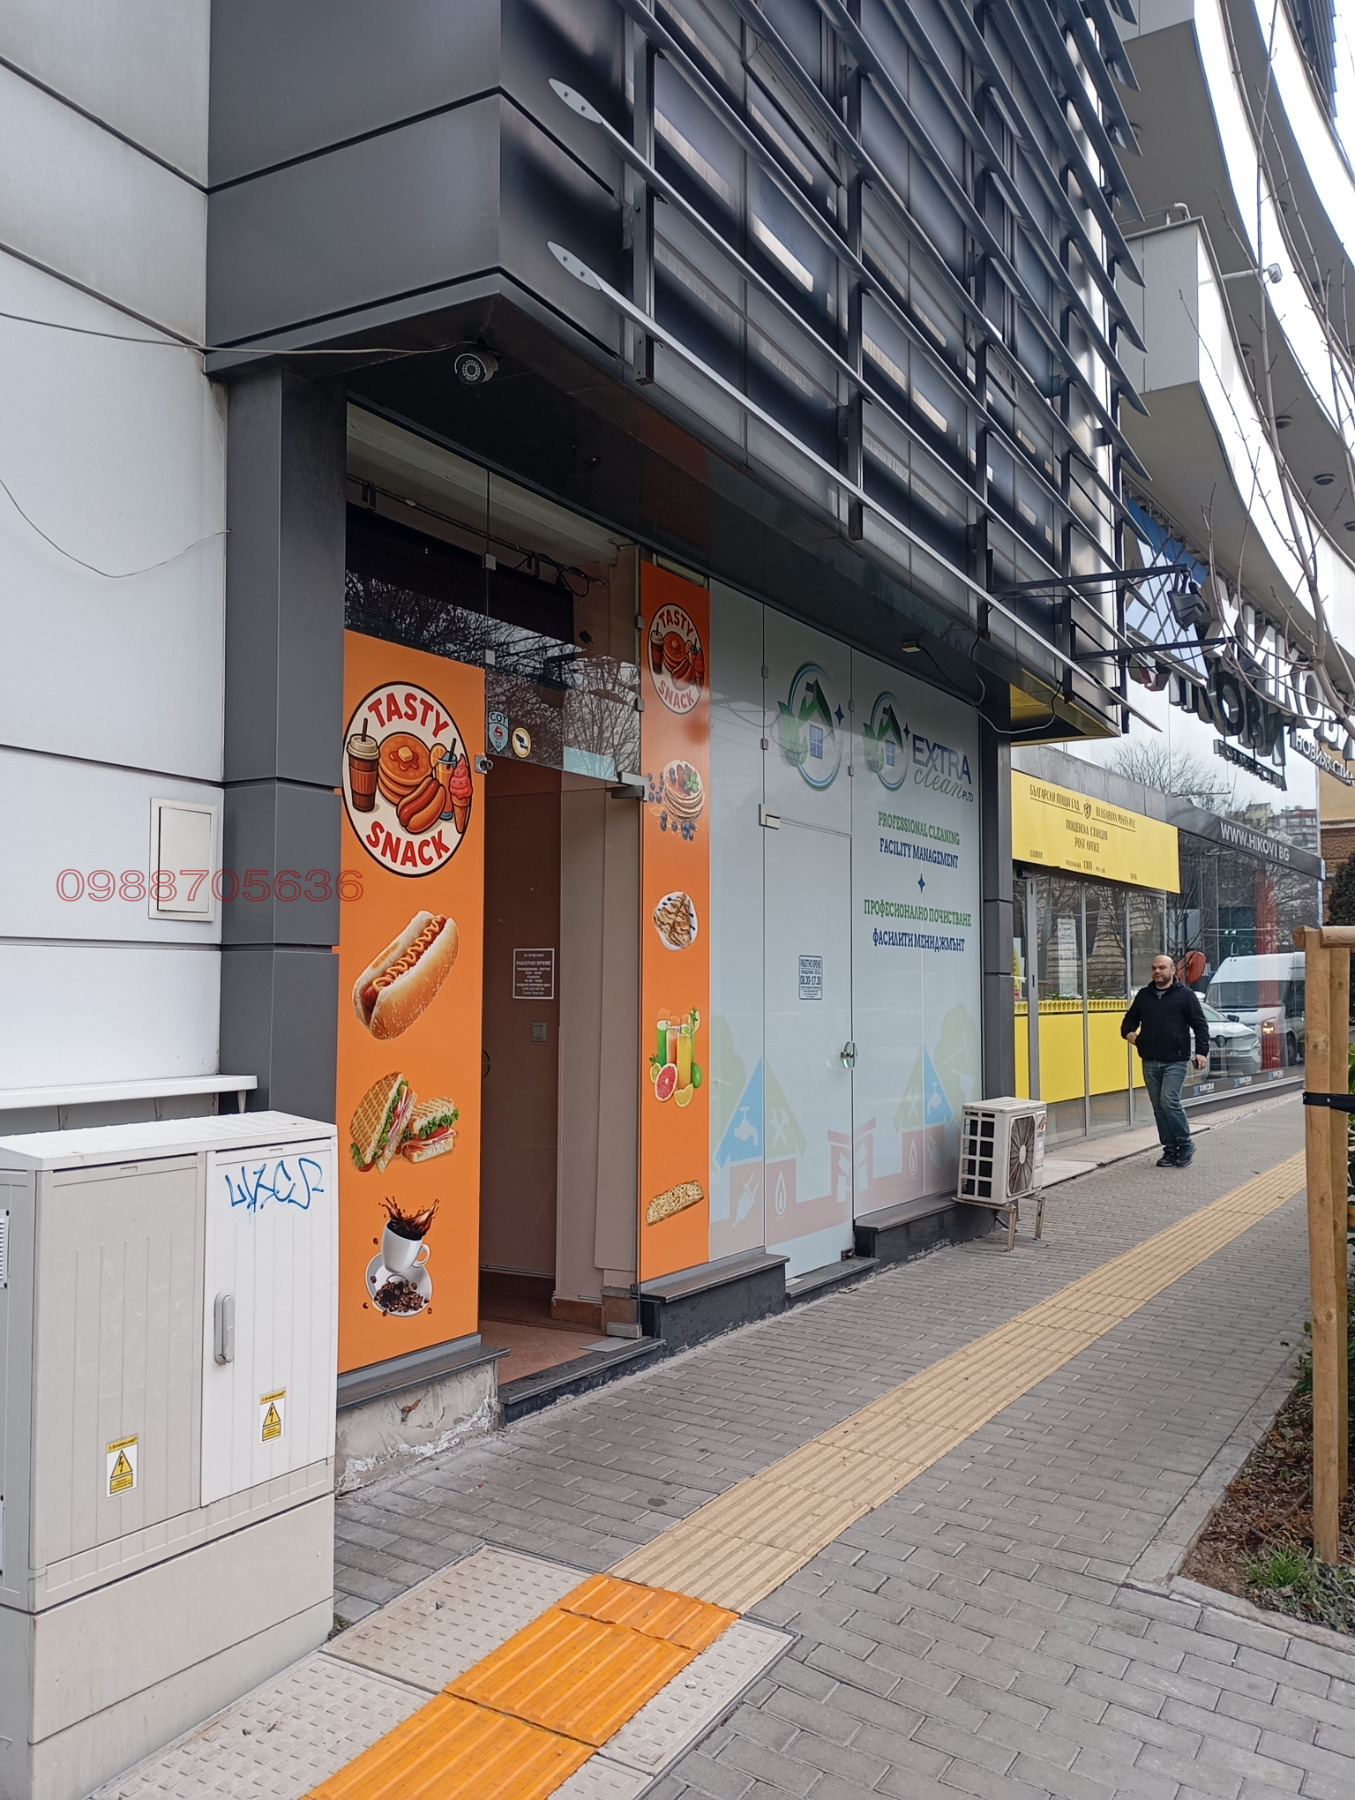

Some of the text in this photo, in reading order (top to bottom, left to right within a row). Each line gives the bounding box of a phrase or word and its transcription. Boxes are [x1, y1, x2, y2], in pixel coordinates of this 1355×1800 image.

[658, 608, 694, 638] TASTY
[658, 679, 695, 710] SNACK
[368, 691, 449, 739] TASTY
[912, 734, 972, 784] EXTRA
[914, 753, 964, 799] clean
[366, 820, 451, 867] SNACK
[878, 811, 960, 845] PROFESSIONAL CLEANING
[1220, 822, 1290, 862] WWW.HIKOVIBG
[880, 838, 959, 869] FACILITY MANAGEMENT
[864, 898, 972, 927] ПРОФЕСИОНАЛНО ПОЧИСТВАНЕ
[872, 927, 965, 953] ФАСИЛИТИ МЕНИДЖМЪНТ
